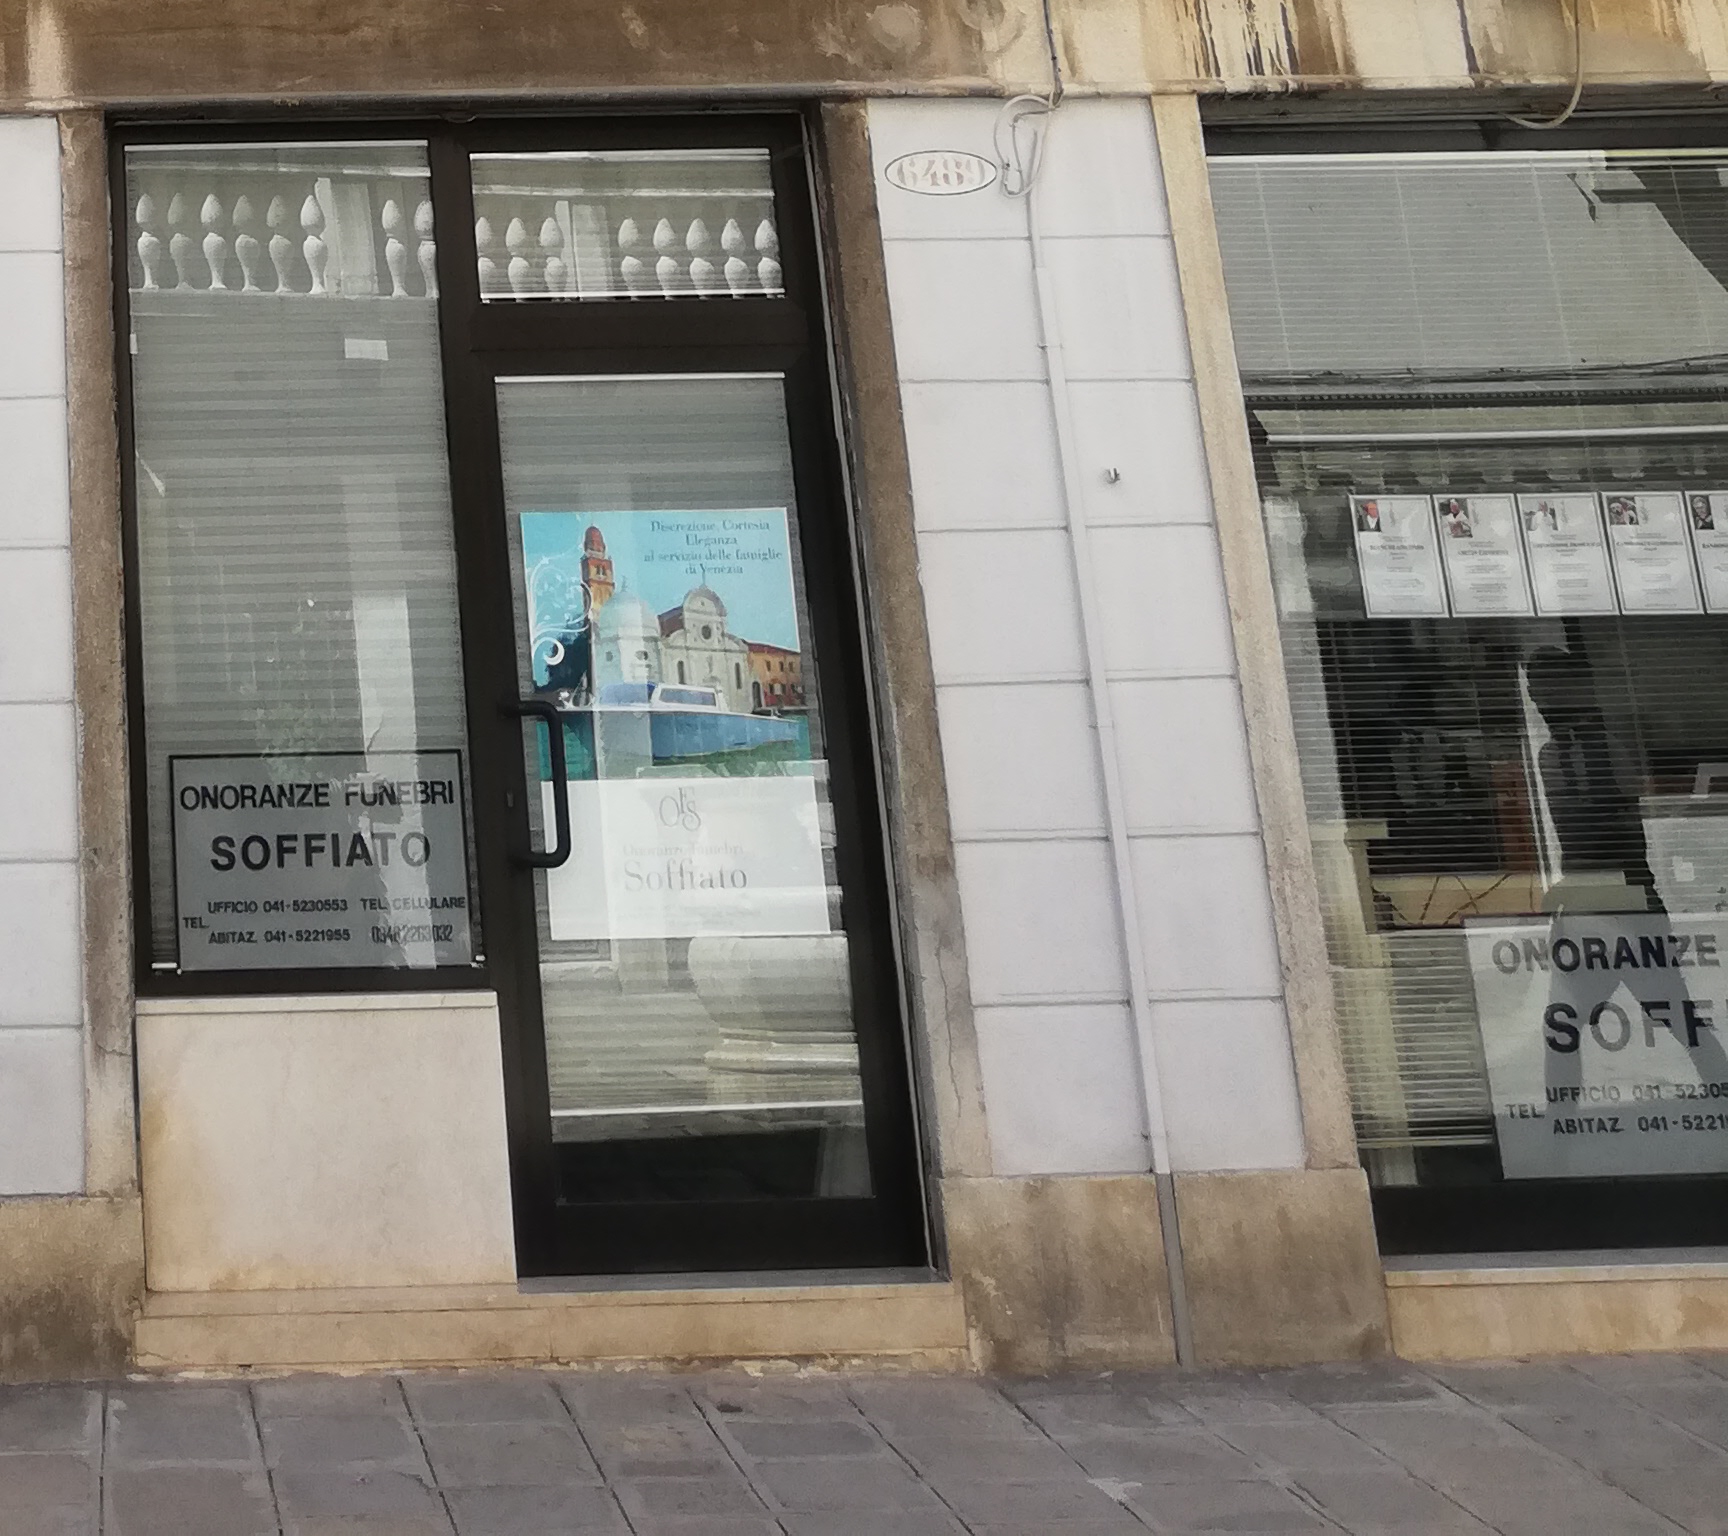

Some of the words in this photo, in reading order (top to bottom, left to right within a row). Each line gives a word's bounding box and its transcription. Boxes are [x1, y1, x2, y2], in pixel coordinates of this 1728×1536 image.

[704, 549, 732, 561] delle
[179, 782, 331, 811] ONORANZE
[344, 779, 454, 808] FUNEBRI
[209, 831, 432, 871] SOFFIATO
[623, 857, 748, 891] Soffiato
[207, 901, 259, 914] UFFICIO
[391, 896, 466, 911] CELLULARE
[1491, 933, 1721, 975] ONORANZE
[1544, 998, 1728, 1054] SOFF
[1545, 1085, 1621, 1104] UFFICIO
